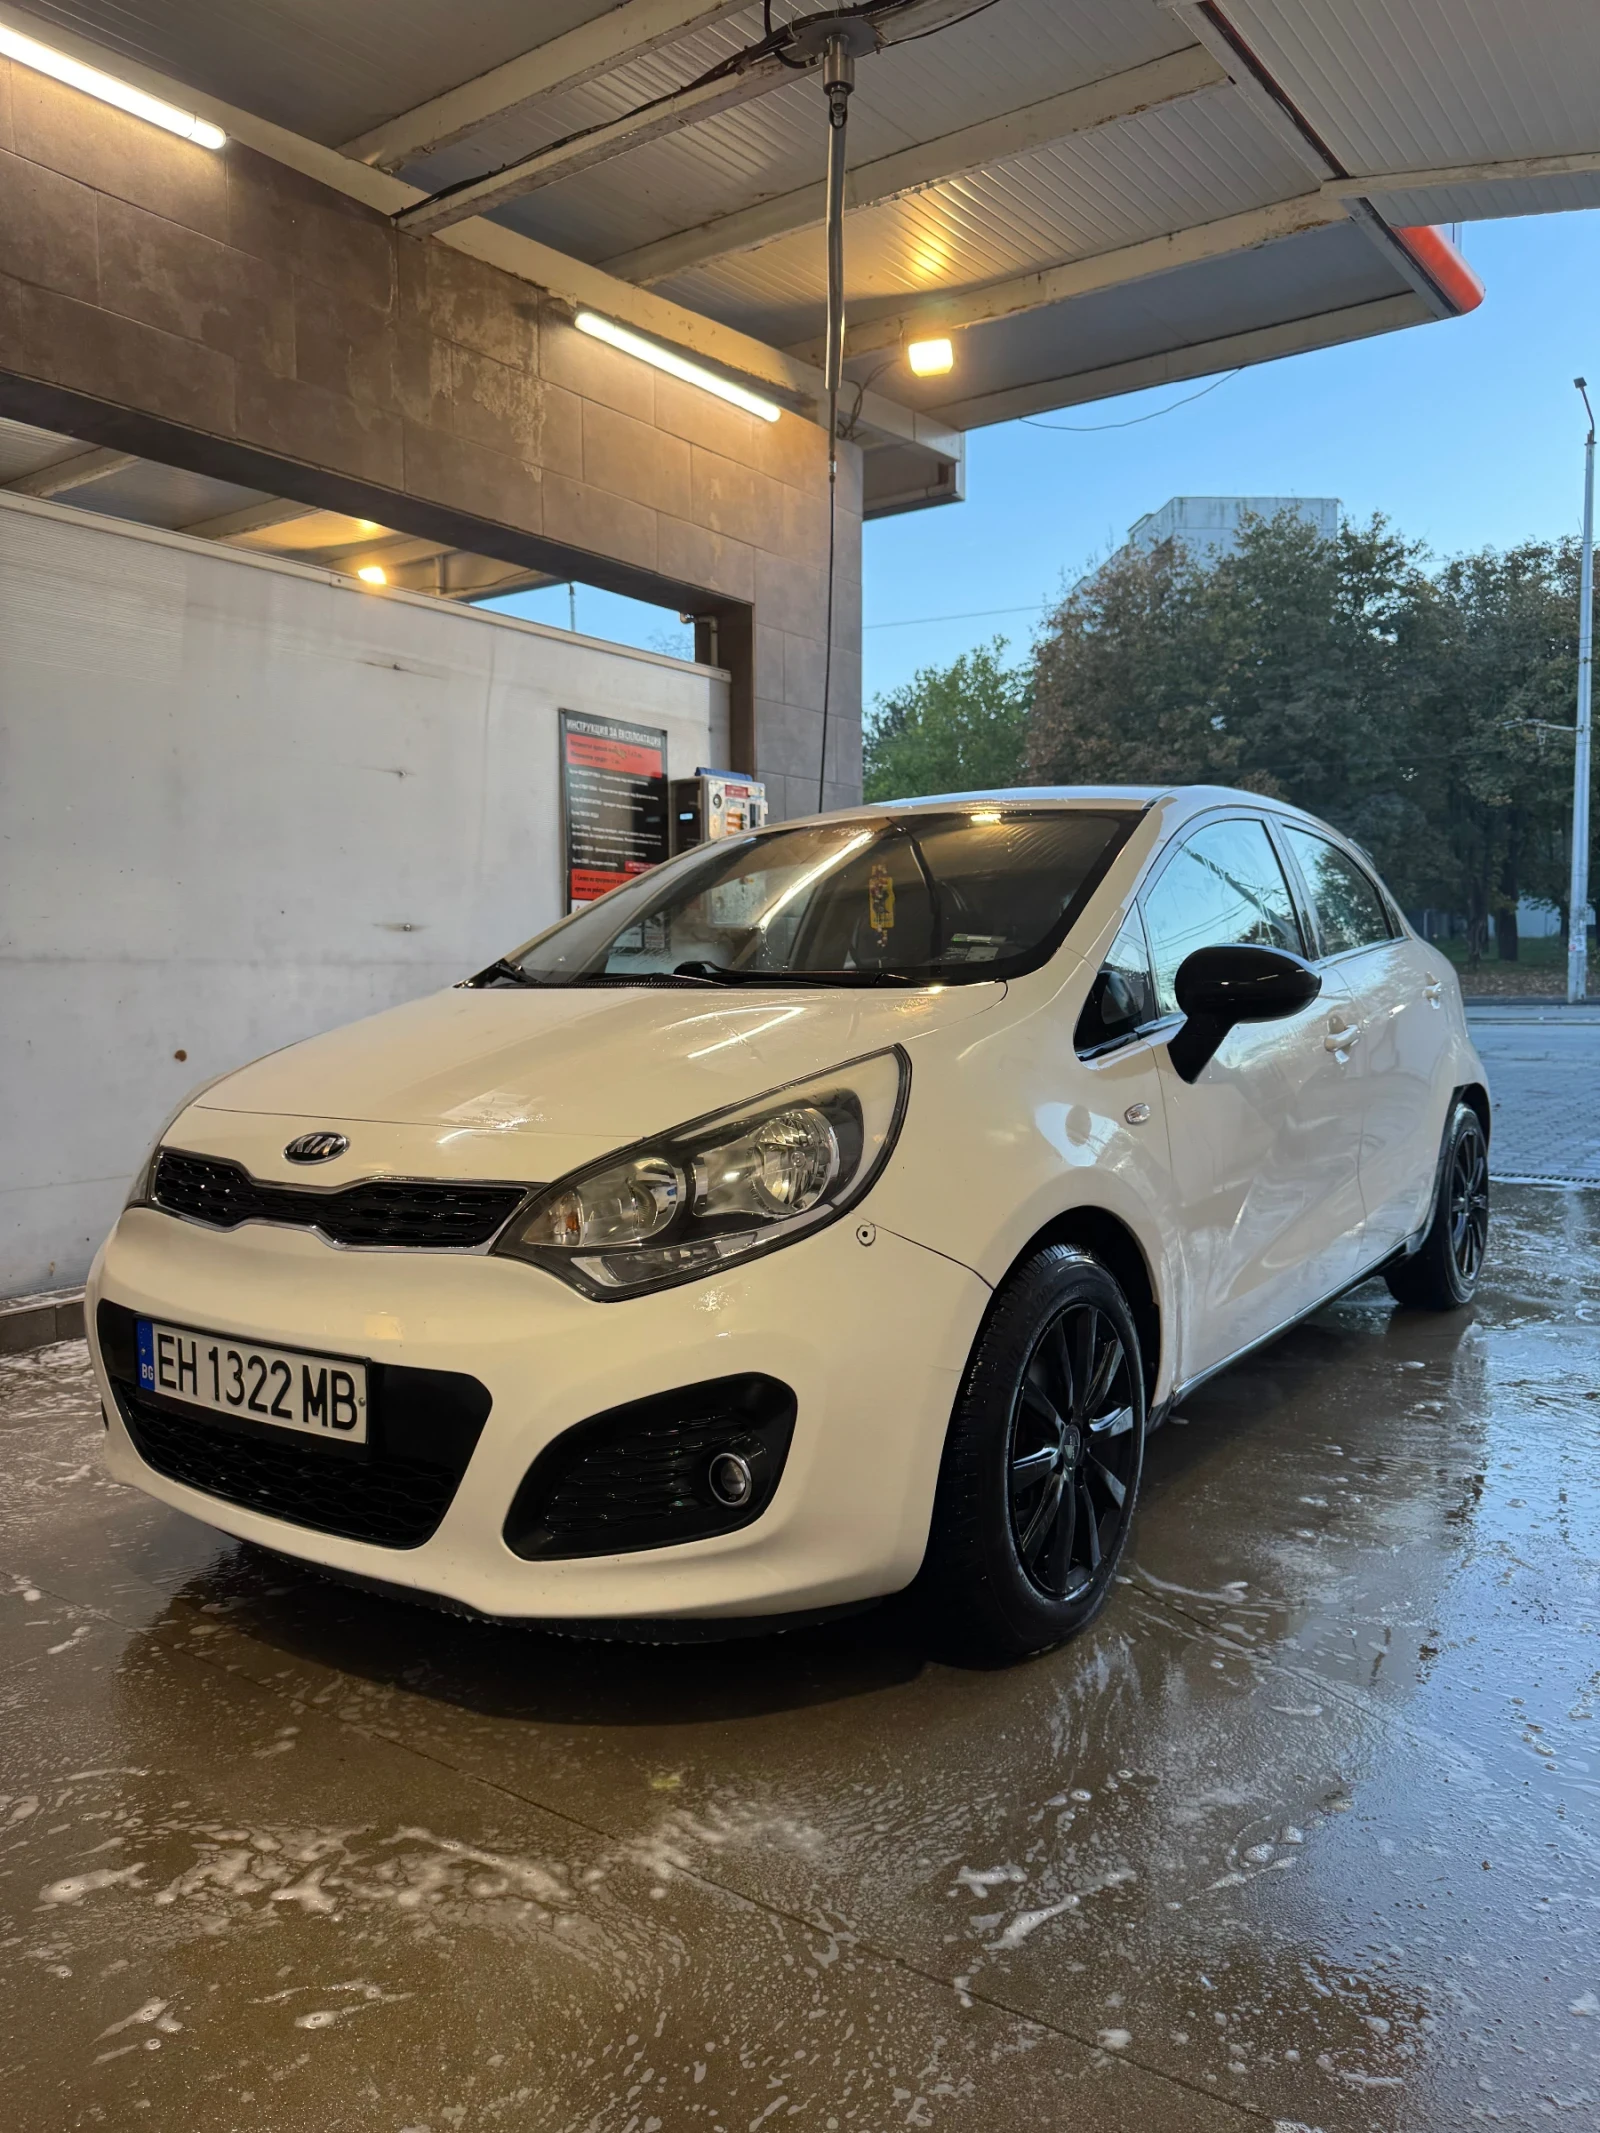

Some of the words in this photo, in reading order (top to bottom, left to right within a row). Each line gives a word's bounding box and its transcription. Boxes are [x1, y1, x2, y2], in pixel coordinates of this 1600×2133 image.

[566, 719, 608, 736] ИНСТРУКЦИЯ
[609, 727, 618, 739] ЗА
[289, 1135, 337, 1156] KIA
[141, 1363, 154, 1380] BG
[157, 1333, 198, 1396] EH
[208, 1346, 293, 1420] 1322
[302, 1364, 358, 1431] MB
